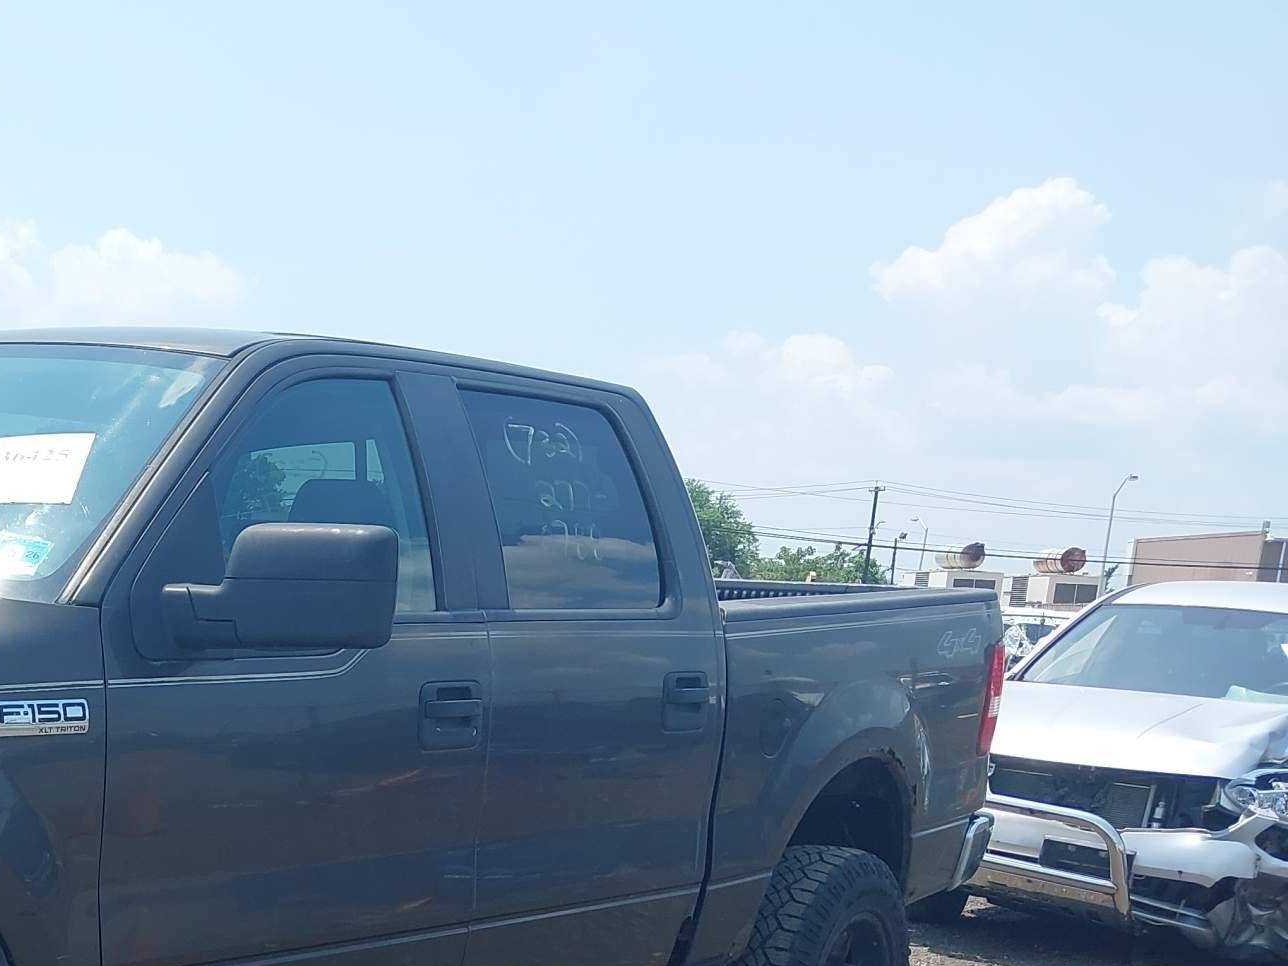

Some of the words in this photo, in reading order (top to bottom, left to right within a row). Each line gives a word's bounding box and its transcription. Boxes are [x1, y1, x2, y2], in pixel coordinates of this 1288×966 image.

[24, 549, 40, 560] 26
[936, 627, 982, 658] 4x4
[37, 726, 54, 734] XLT
[54, 725, 87, 734] TRITON
